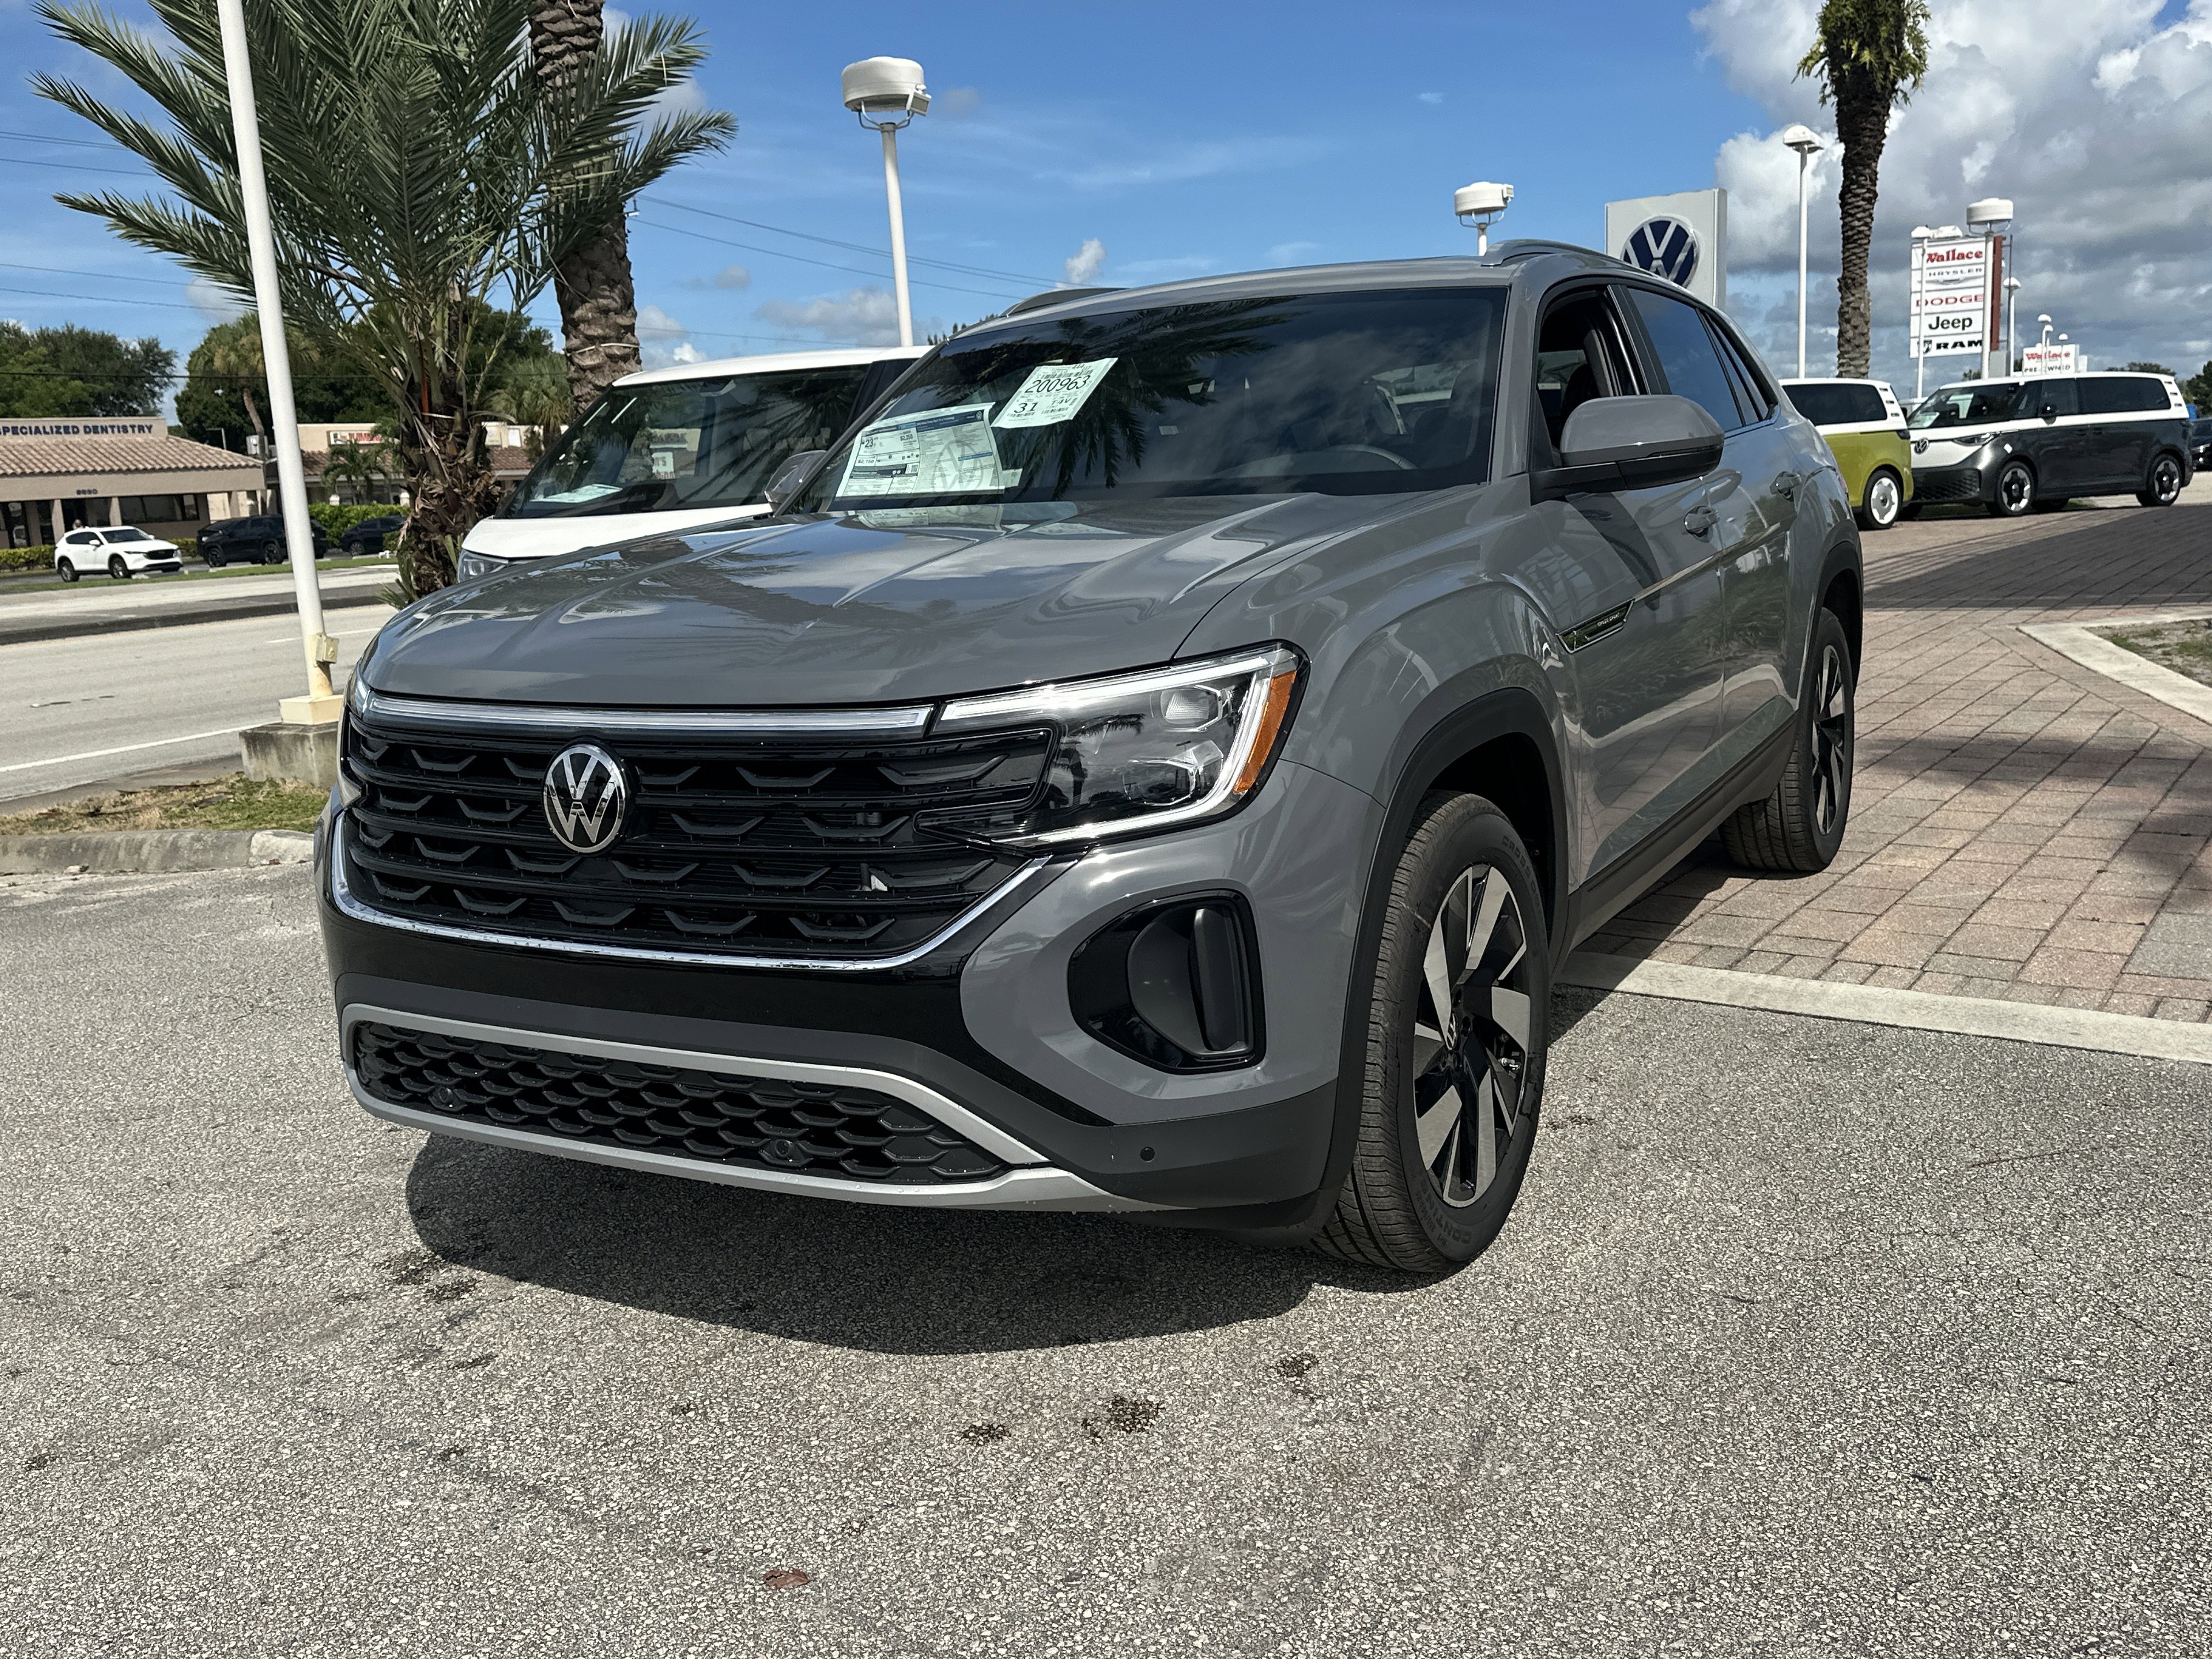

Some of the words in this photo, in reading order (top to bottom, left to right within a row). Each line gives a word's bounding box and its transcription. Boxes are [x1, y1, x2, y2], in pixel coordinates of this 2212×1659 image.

[1926, 249, 1983, 263] Wallace
[1928, 268, 1982, 276] HRYSLER
[1928, 316, 1972, 330] Jeep
[1936, 339, 1982, 350] RAM
[1025, 375, 1091, 393] 200963
[1014, 402, 1039, 413] 31
[0, 425, 80, 436] PECIALIZED
[83, 424, 153, 435] DENTISTRY
[865, 438, 873, 448] 23
[544, 744, 625, 853] VW
